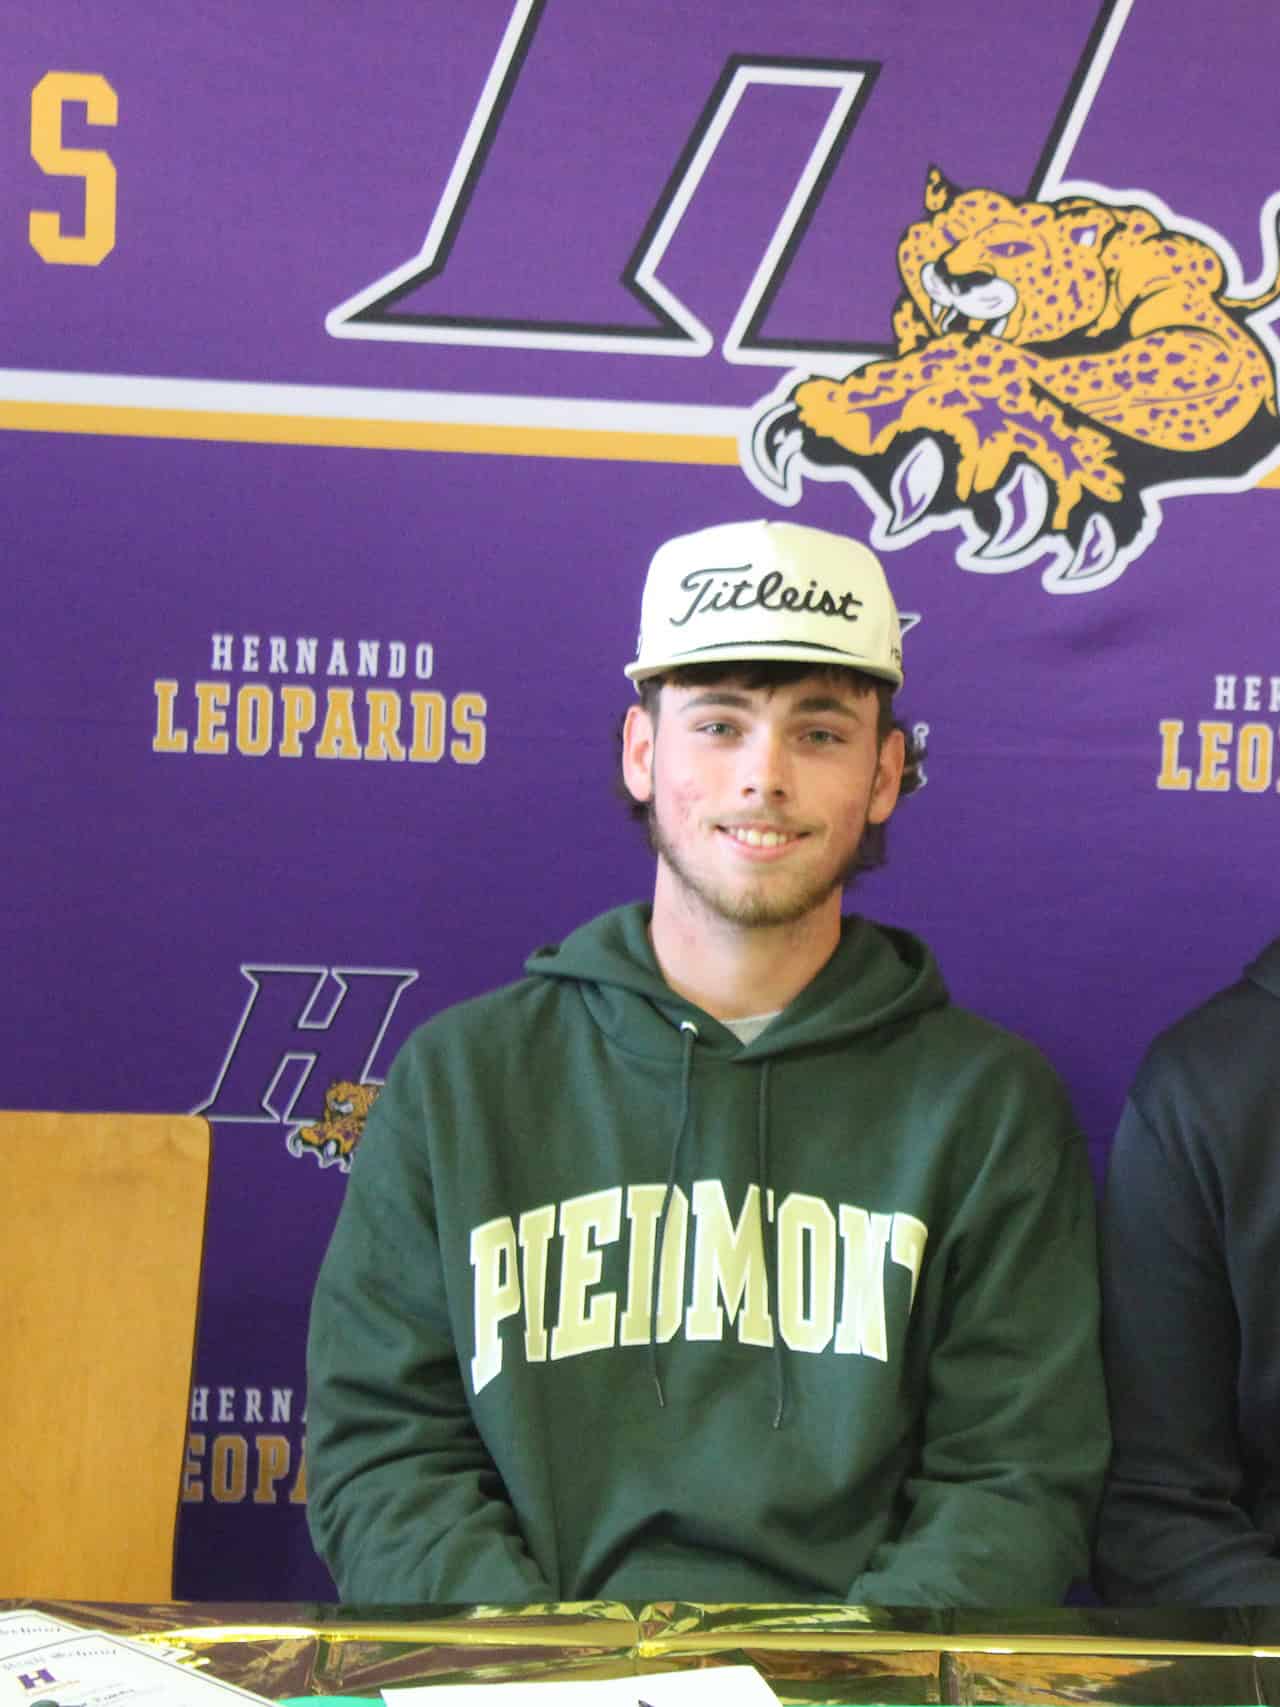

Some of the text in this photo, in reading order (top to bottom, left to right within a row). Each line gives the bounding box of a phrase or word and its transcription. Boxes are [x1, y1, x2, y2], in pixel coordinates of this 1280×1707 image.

[670, 563, 863, 626] Titleist
[210, 633, 434, 679] HERNANDO
[152, 679, 487, 764] LEOPARDS
[191, 1386, 308, 1423] HERN
